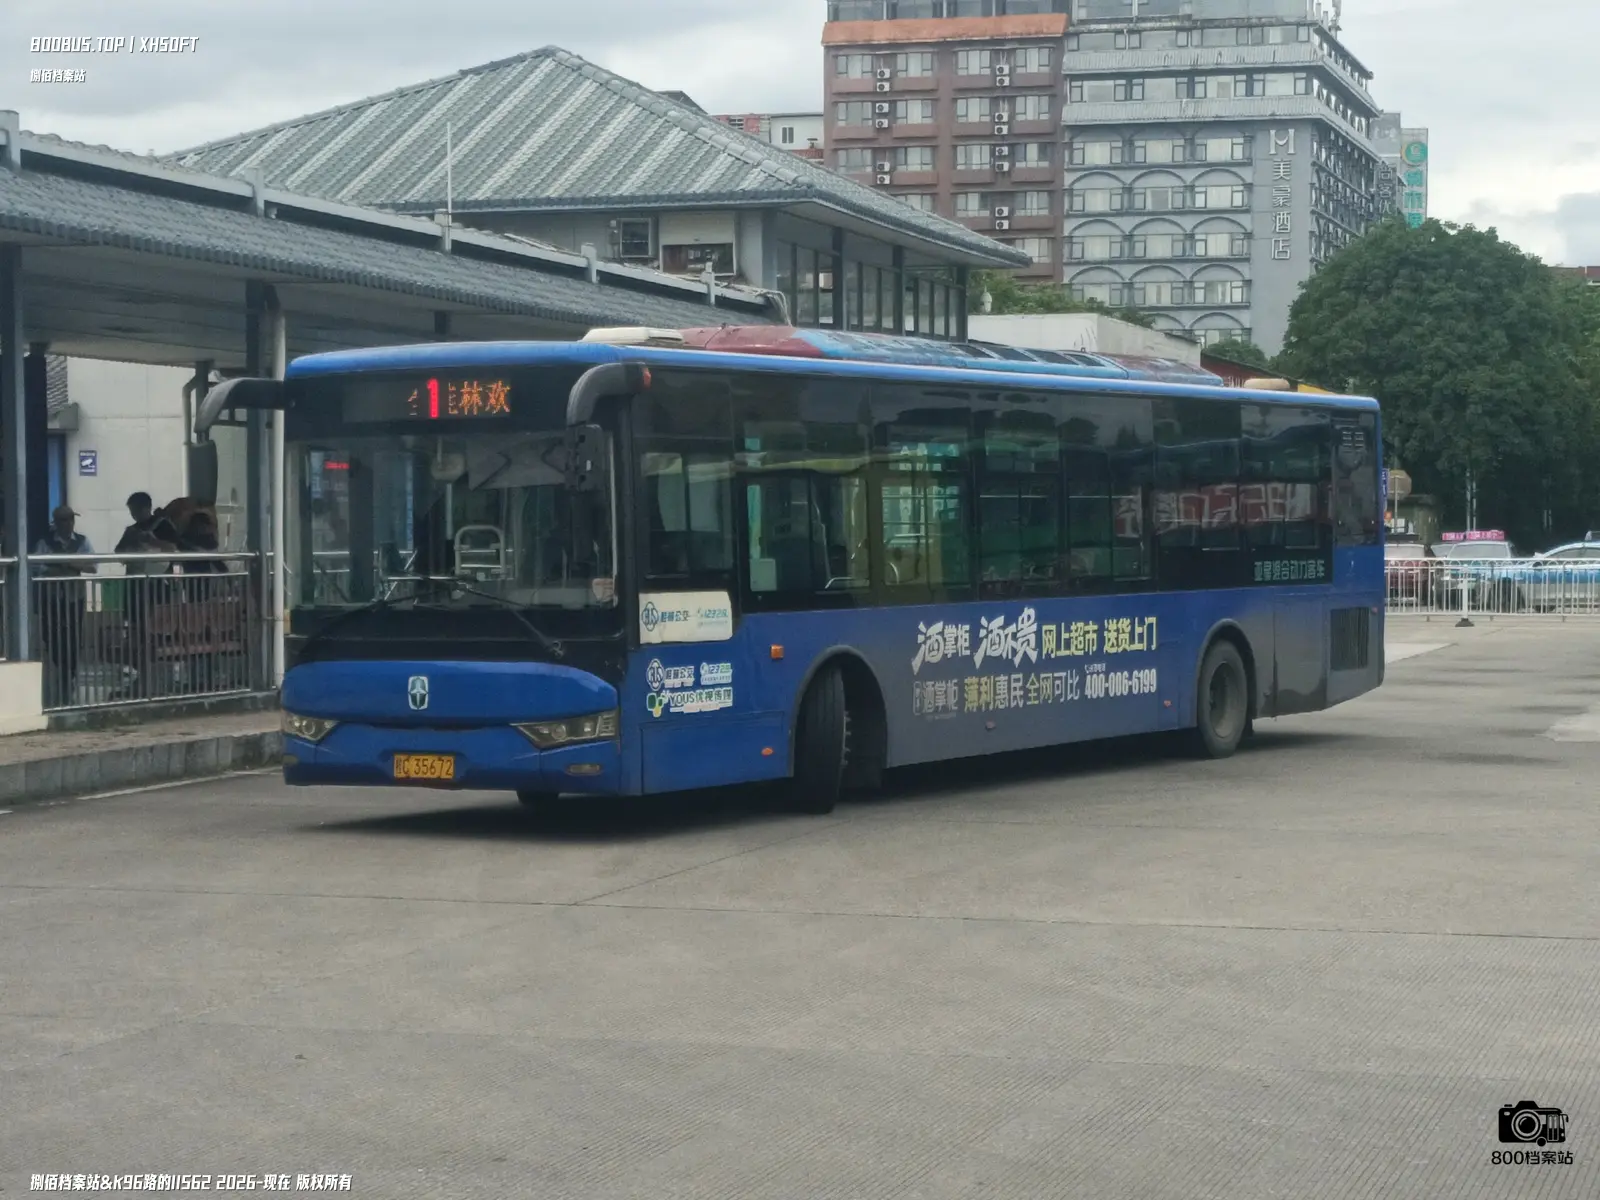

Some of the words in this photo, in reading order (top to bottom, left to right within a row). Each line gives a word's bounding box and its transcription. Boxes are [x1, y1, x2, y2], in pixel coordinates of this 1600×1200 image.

[1271, 159, 1292, 260] 美豪酒店
[426, 377, 439, 419] 1
[911, 620, 970, 675] 酒掌柜
[1041, 620, 1098, 660] 网上超市
[1103, 616, 1157, 654] 送货上门
[922, 678, 958, 714] 酒掌柜
[1084, 667, 1157, 699] 400-006-6199
